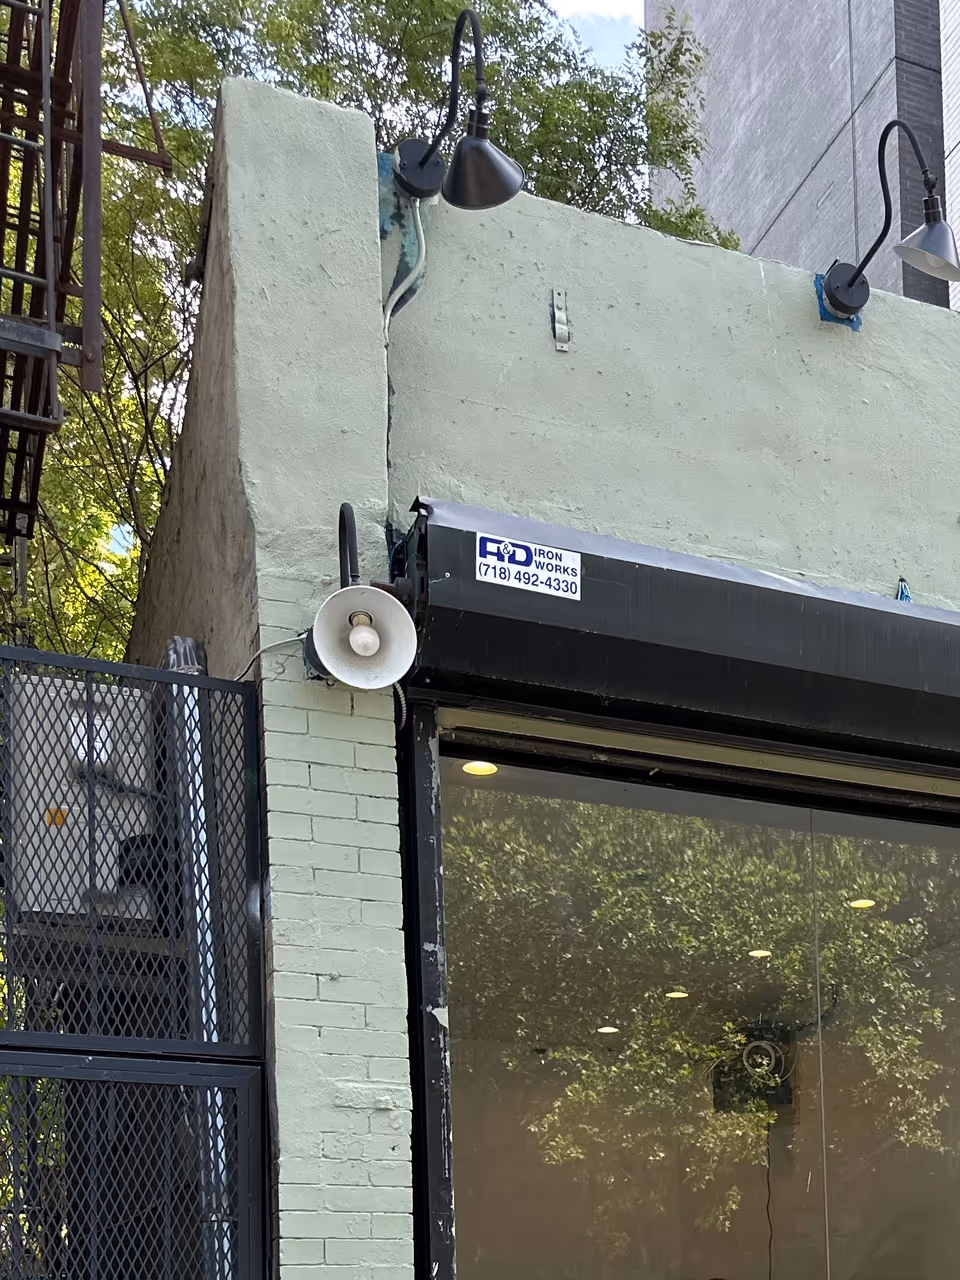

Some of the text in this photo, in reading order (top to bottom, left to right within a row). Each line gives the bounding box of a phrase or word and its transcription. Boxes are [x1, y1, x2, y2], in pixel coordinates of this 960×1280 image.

[534, 548, 563, 562] IRON
[535, 560, 578, 577] WORKS
[479, 562, 577, 594] (718) 492-4330
